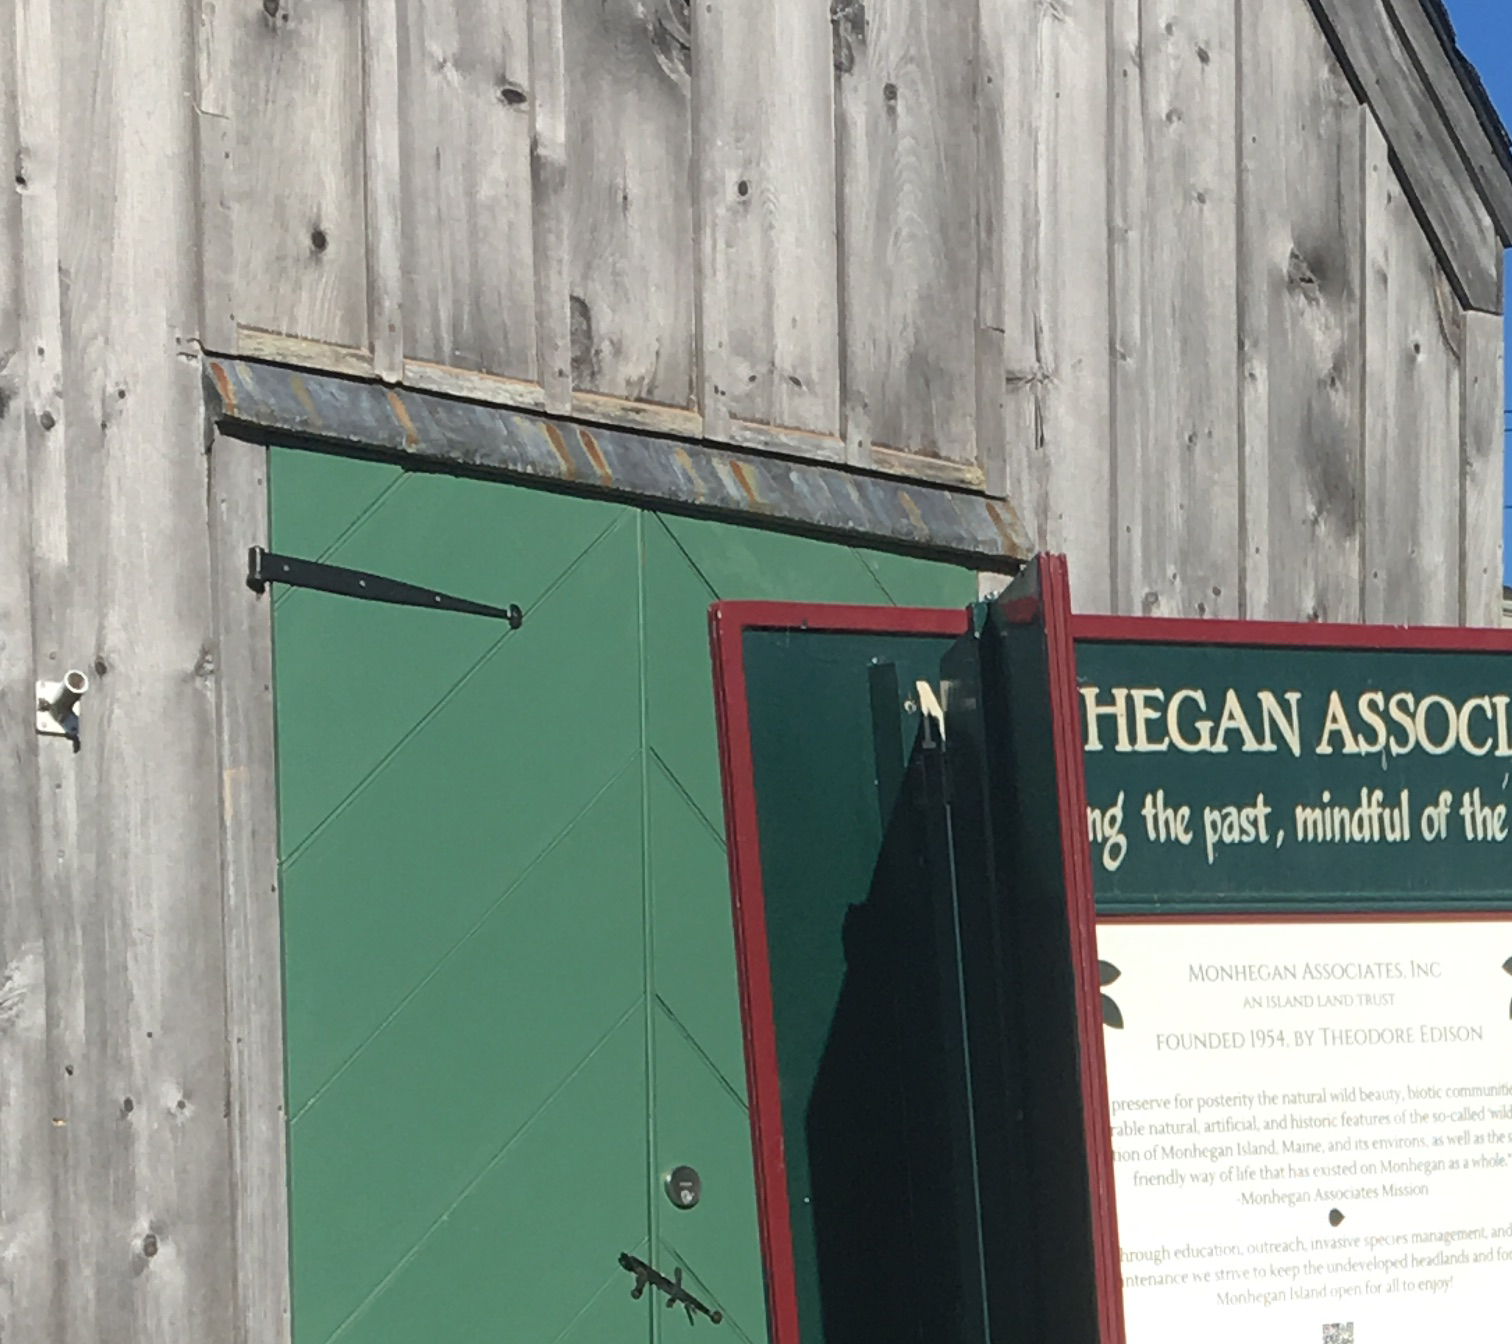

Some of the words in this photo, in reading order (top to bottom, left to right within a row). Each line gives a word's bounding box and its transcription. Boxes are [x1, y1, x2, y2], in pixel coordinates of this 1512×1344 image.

[1086, 790, 1128, 872] ng
[1141, 788, 1193, 845] the
[1204, 792, 1284, 865] past,
[1295, 786, 1410, 843] mindful
[1421, 790, 1452, 842] of
[1459, 787, 1508, 842] the
[1242, 995, 1263, 1009] AN
[1265, 994, 1314, 1008] ISLAND
[1316, 993, 1354, 1007] LAND
[1356, 992, 1395, 1006] TRUST
[1155, 1031, 1245, 1050] FOUNDED
[1293, 1029, 1314, 1046] BY
[1318, 1026, 1414, 1046] THEODORE
[1419, 1024, 1482, 1043] EDISON
[1112, 1098, 1171, 1117] preserve
[1173, 1092, 1193, 1109] for
[1196, 1091, 1254, 1113] posterity
[1256, 1089, 1278, 1106] the
[1281, 1087, 1326, 1105] natural
[1329, 1086, 1356, 1102] wild
[1407, 1083, 1442, 1101] biotic
[1111, 1120, 1145, 1137] rable
[1262, 1113, 1287, 1130] and
[1289, 1113, 1337, 1129] historic
[1340, 1110, 1391, 1127] features
[1393, 1109, 1406, 1124] of
[1409, 1108, 1429, 1124] the
[1143, 1143, 1159, 1160] of
[1160, 1142, 1233, 1163] Monhegan
[1327, 1135, 1351, 1152] and
[1354, 1137, 1369, 1150] its
[1431, 1135, 1444, 1146] as
[1446, 1129, 1470, 1145] well
[1472, 1133, 1484, 1145] as
[1486, 1128, 1505, 1144] the
[1132, 1168, 1186, 1188] friendly
[1189, 1171, 1215, 1186] way
[1219, 1165, 1234, 1182] of
[1235, 1164, 1256, 1181] life
[1259, 1164, 1284, 1180] that
[1287, 1162, 1309, 1178] has
[1312, 1159, 1357, 1177] existed
[1359, 1163, 1377, 1174] on
[1379, 1156, 1445, 1176] Monhegan
[1447, 1158, 1460, 1170] as
[1462, 1158, 1469, 1169] a
[1313, 1186, 1379, 1202] Associates
[1381, 1183, 1428, 1197] Mission
[1119, 1245, 1171, 1267] hrough
[1310, 1236, 1360, 1250] invasive
[1363, 1233, 1408, 1251] species
[1490, 1221, 1512, 1238] and
[1123, 1274, 1189, 1288] ntenance
[1192, 1271, 1210, 1282] we
[1214, 1268, 1249, 1281] strive
[1252, 1266, 1266, 1278] to
[1269, 1263, 1300, 1281] keep
[1302, 1259, 1324, 1275] the
[1326, 1252, 1408, 1274] undeveloped
[1410, 1248, 1469, 1268] headlands
[1472, 1246, 1493, 1263] and
[1216, 1287, 1286, 1307] Monhegan
[1289, 1283, 1326, 1300] Island
[1329, 1284, 1362, 1300] open
[1365, 1279, 1382, 1294] for
[1385, 1277, 1399, 1293] all
[1402, 1279, 1415, 1291] to
